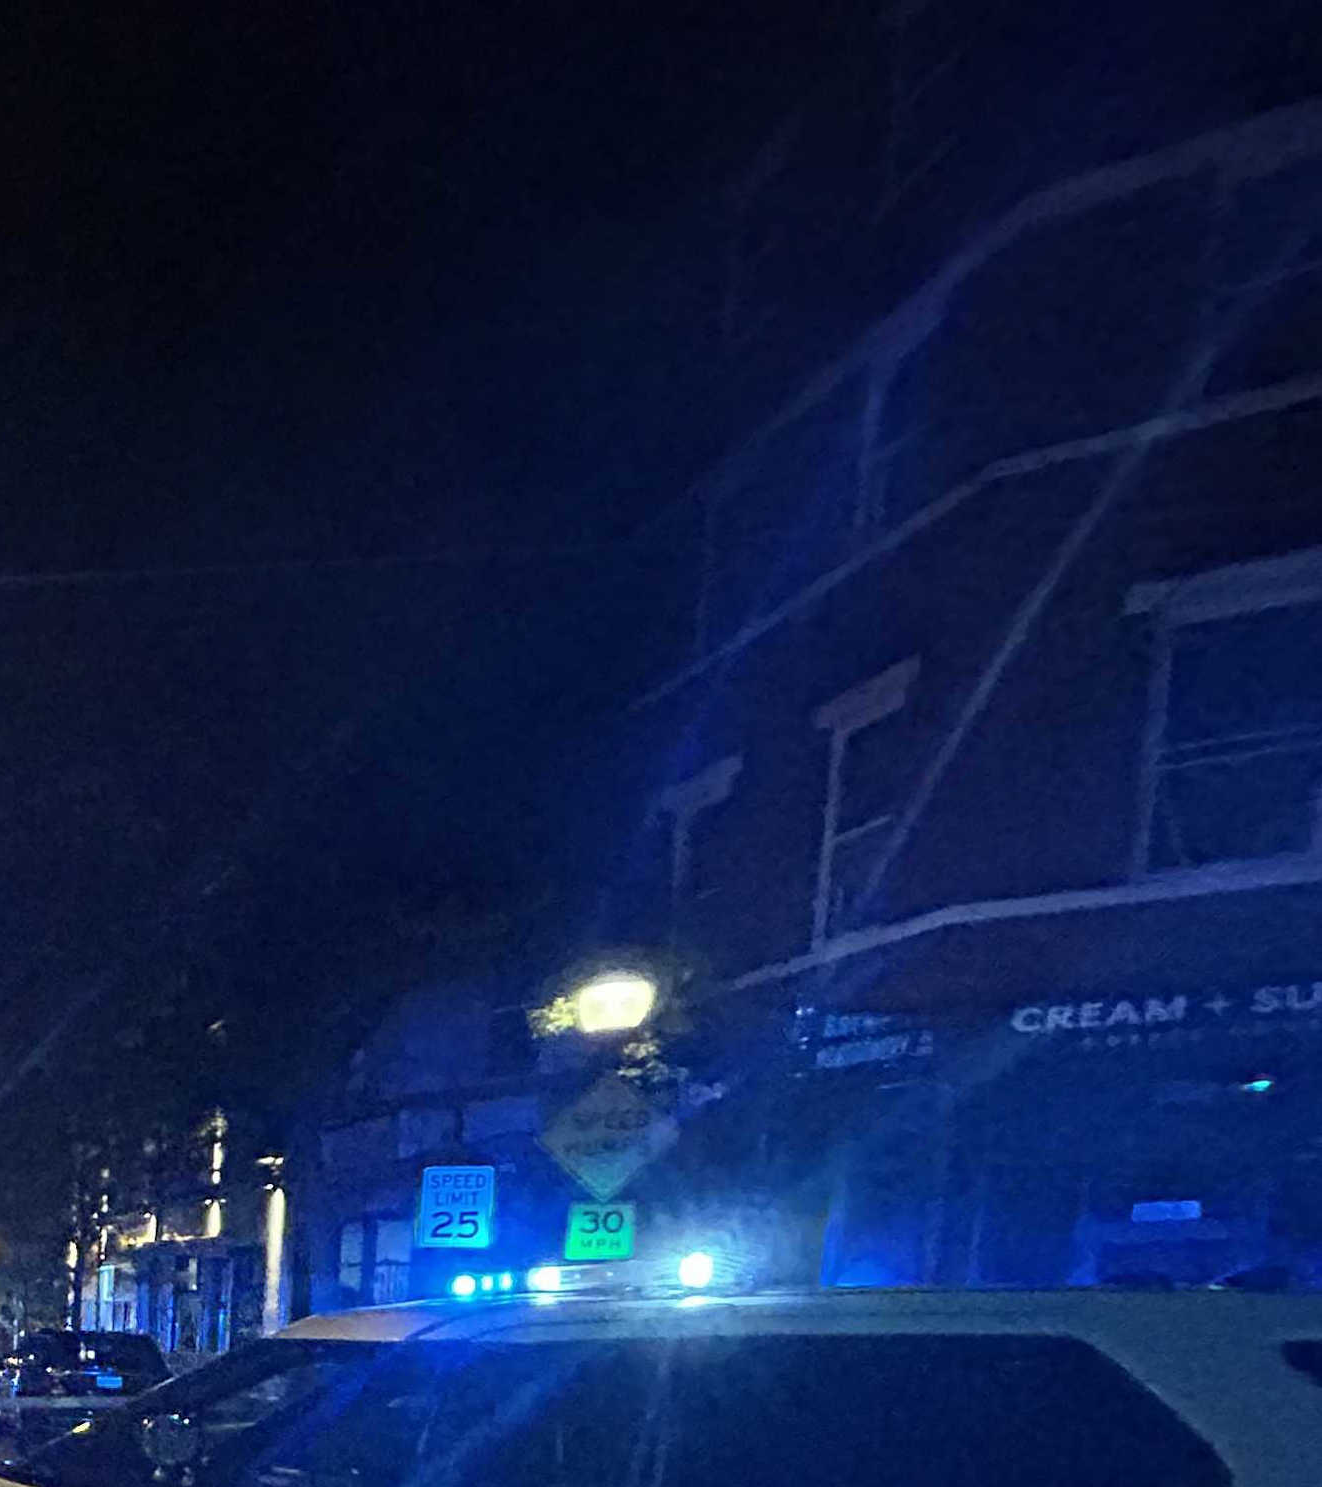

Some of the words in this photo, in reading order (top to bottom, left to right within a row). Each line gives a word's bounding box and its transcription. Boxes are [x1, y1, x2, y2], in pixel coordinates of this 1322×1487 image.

[1010, 994, 1188, 1034] CREAM
[430, 1173, 486, 1190] SPEED
[435, 1190, 479, 1207] LIMIT
[430, 1211, 479, 1238] 25
[579, 1210, 624, 1234] 30
[580, 1238, 622, 1249] MPH
